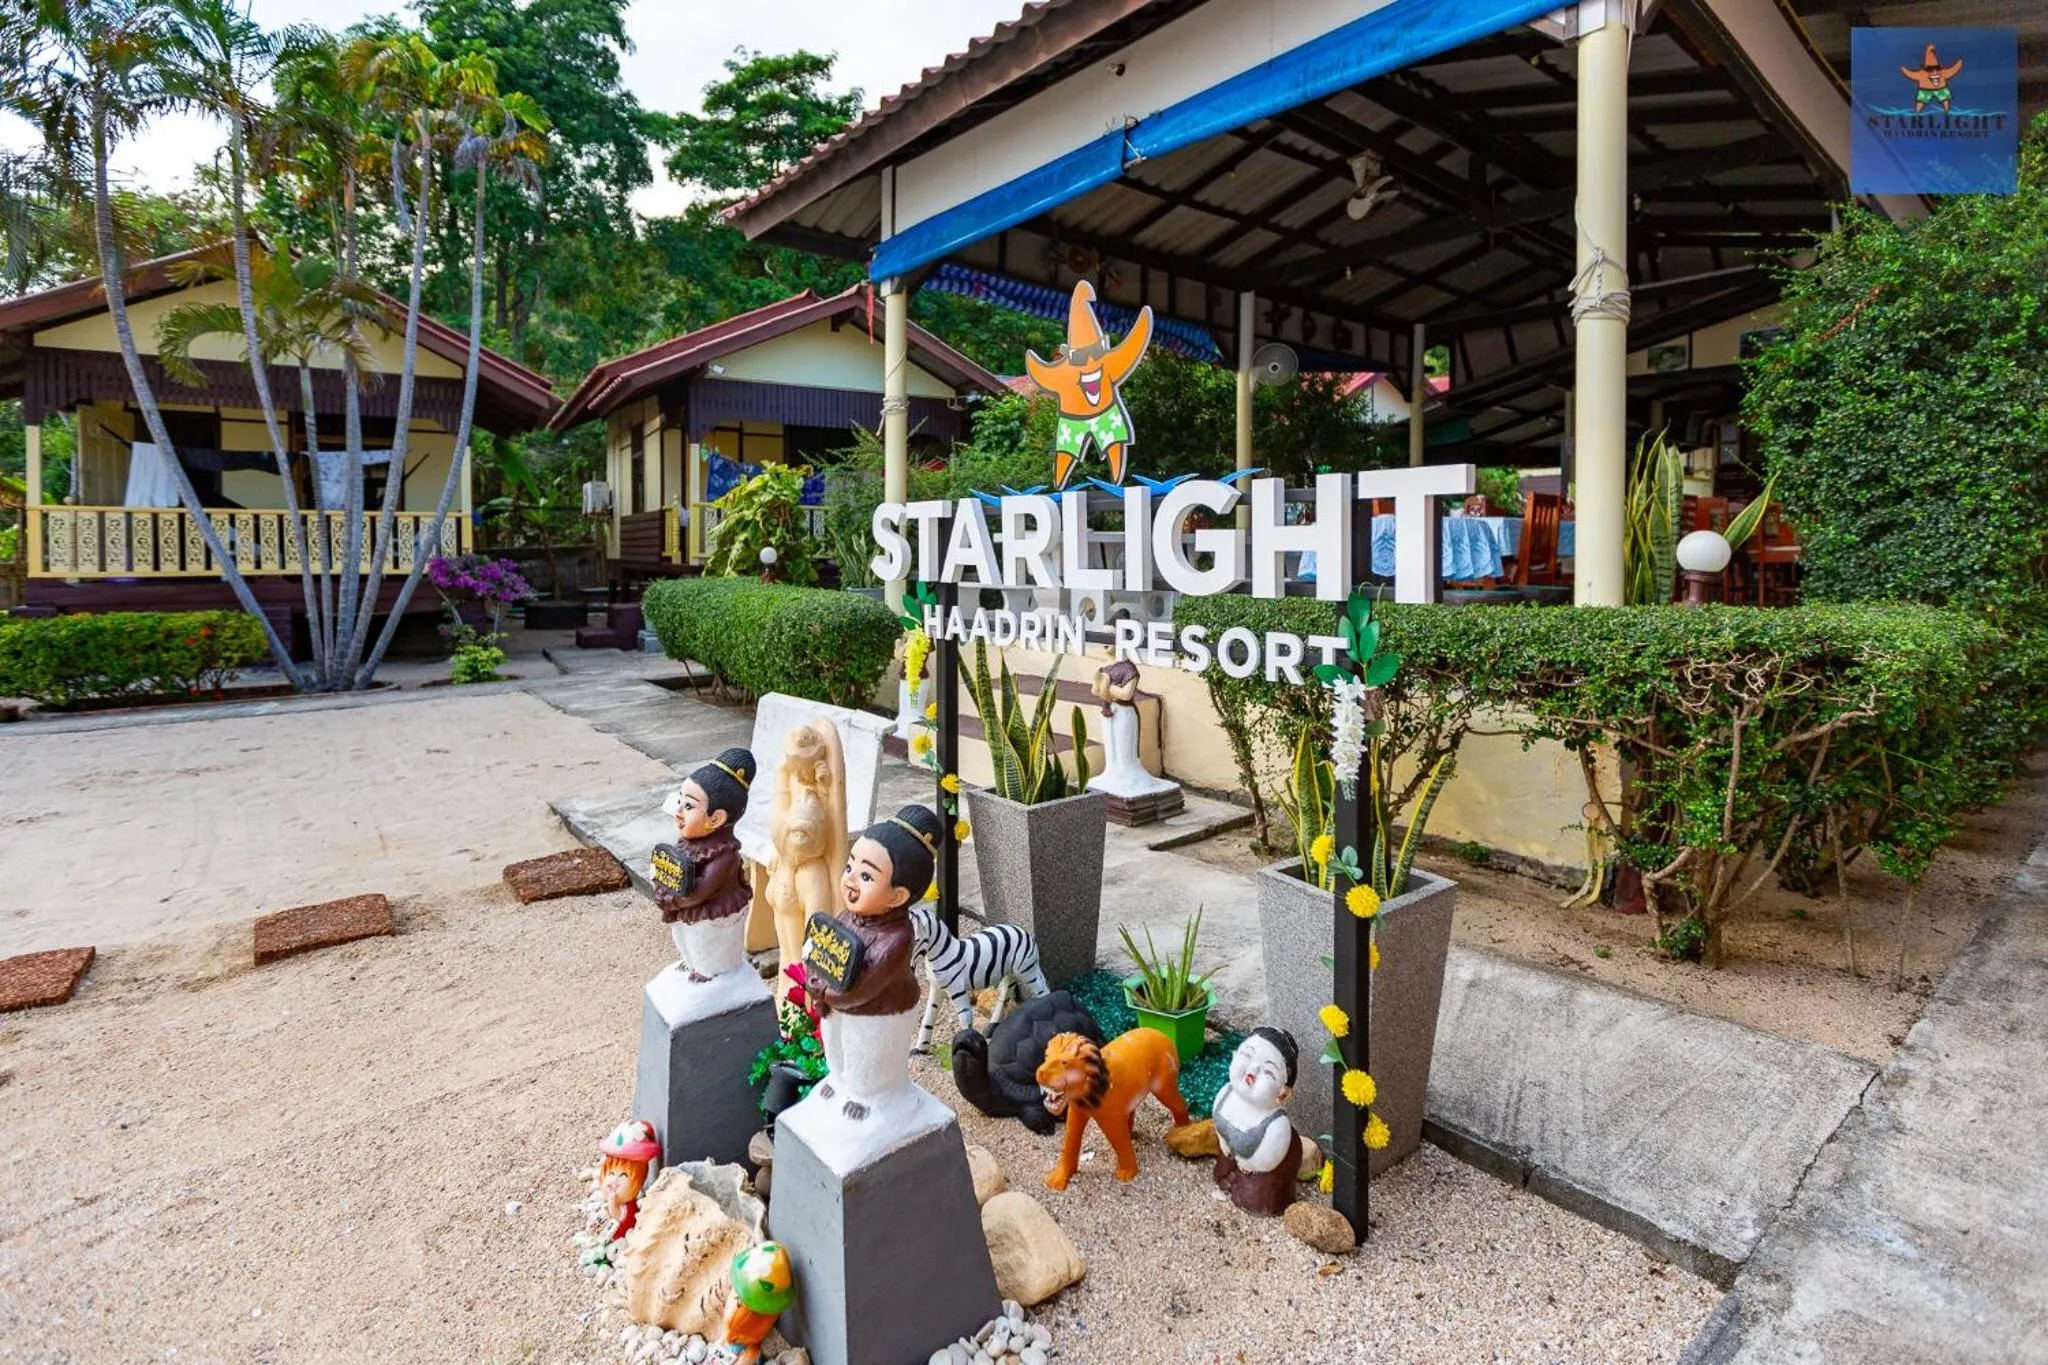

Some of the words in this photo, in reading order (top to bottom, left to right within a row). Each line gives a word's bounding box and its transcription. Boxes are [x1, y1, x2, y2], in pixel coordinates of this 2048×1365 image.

[871, 463, 1476, 604] STARLIGHT
[924, 605, 1085, 656] HAADRIN
[1115, 618, 1349, 688] RESORT
